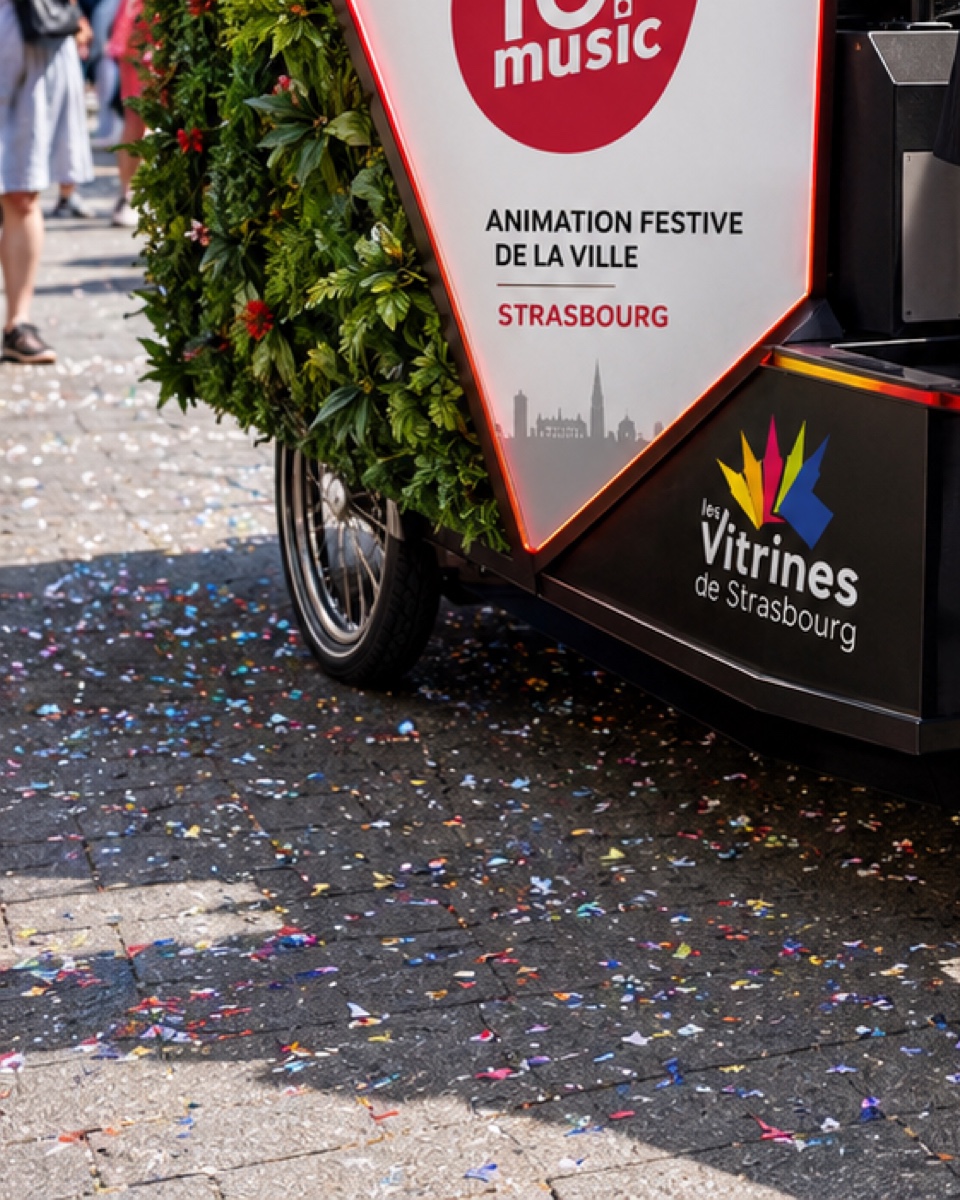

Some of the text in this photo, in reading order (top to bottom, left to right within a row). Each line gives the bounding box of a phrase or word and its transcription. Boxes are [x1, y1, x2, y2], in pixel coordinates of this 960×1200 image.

[494, 16, 662, 88] music
[486, 209, 743, 235] ANIMATION FESTIVE
[495, 243, 638, 268] DE LA VILLE
[498, 303, 668, 328] STRASBOURG
[701, 498, 720, 520] les
[701, 508, 859, 607] Vitrines
[695, 572, 857, 653] de Strasbourg
